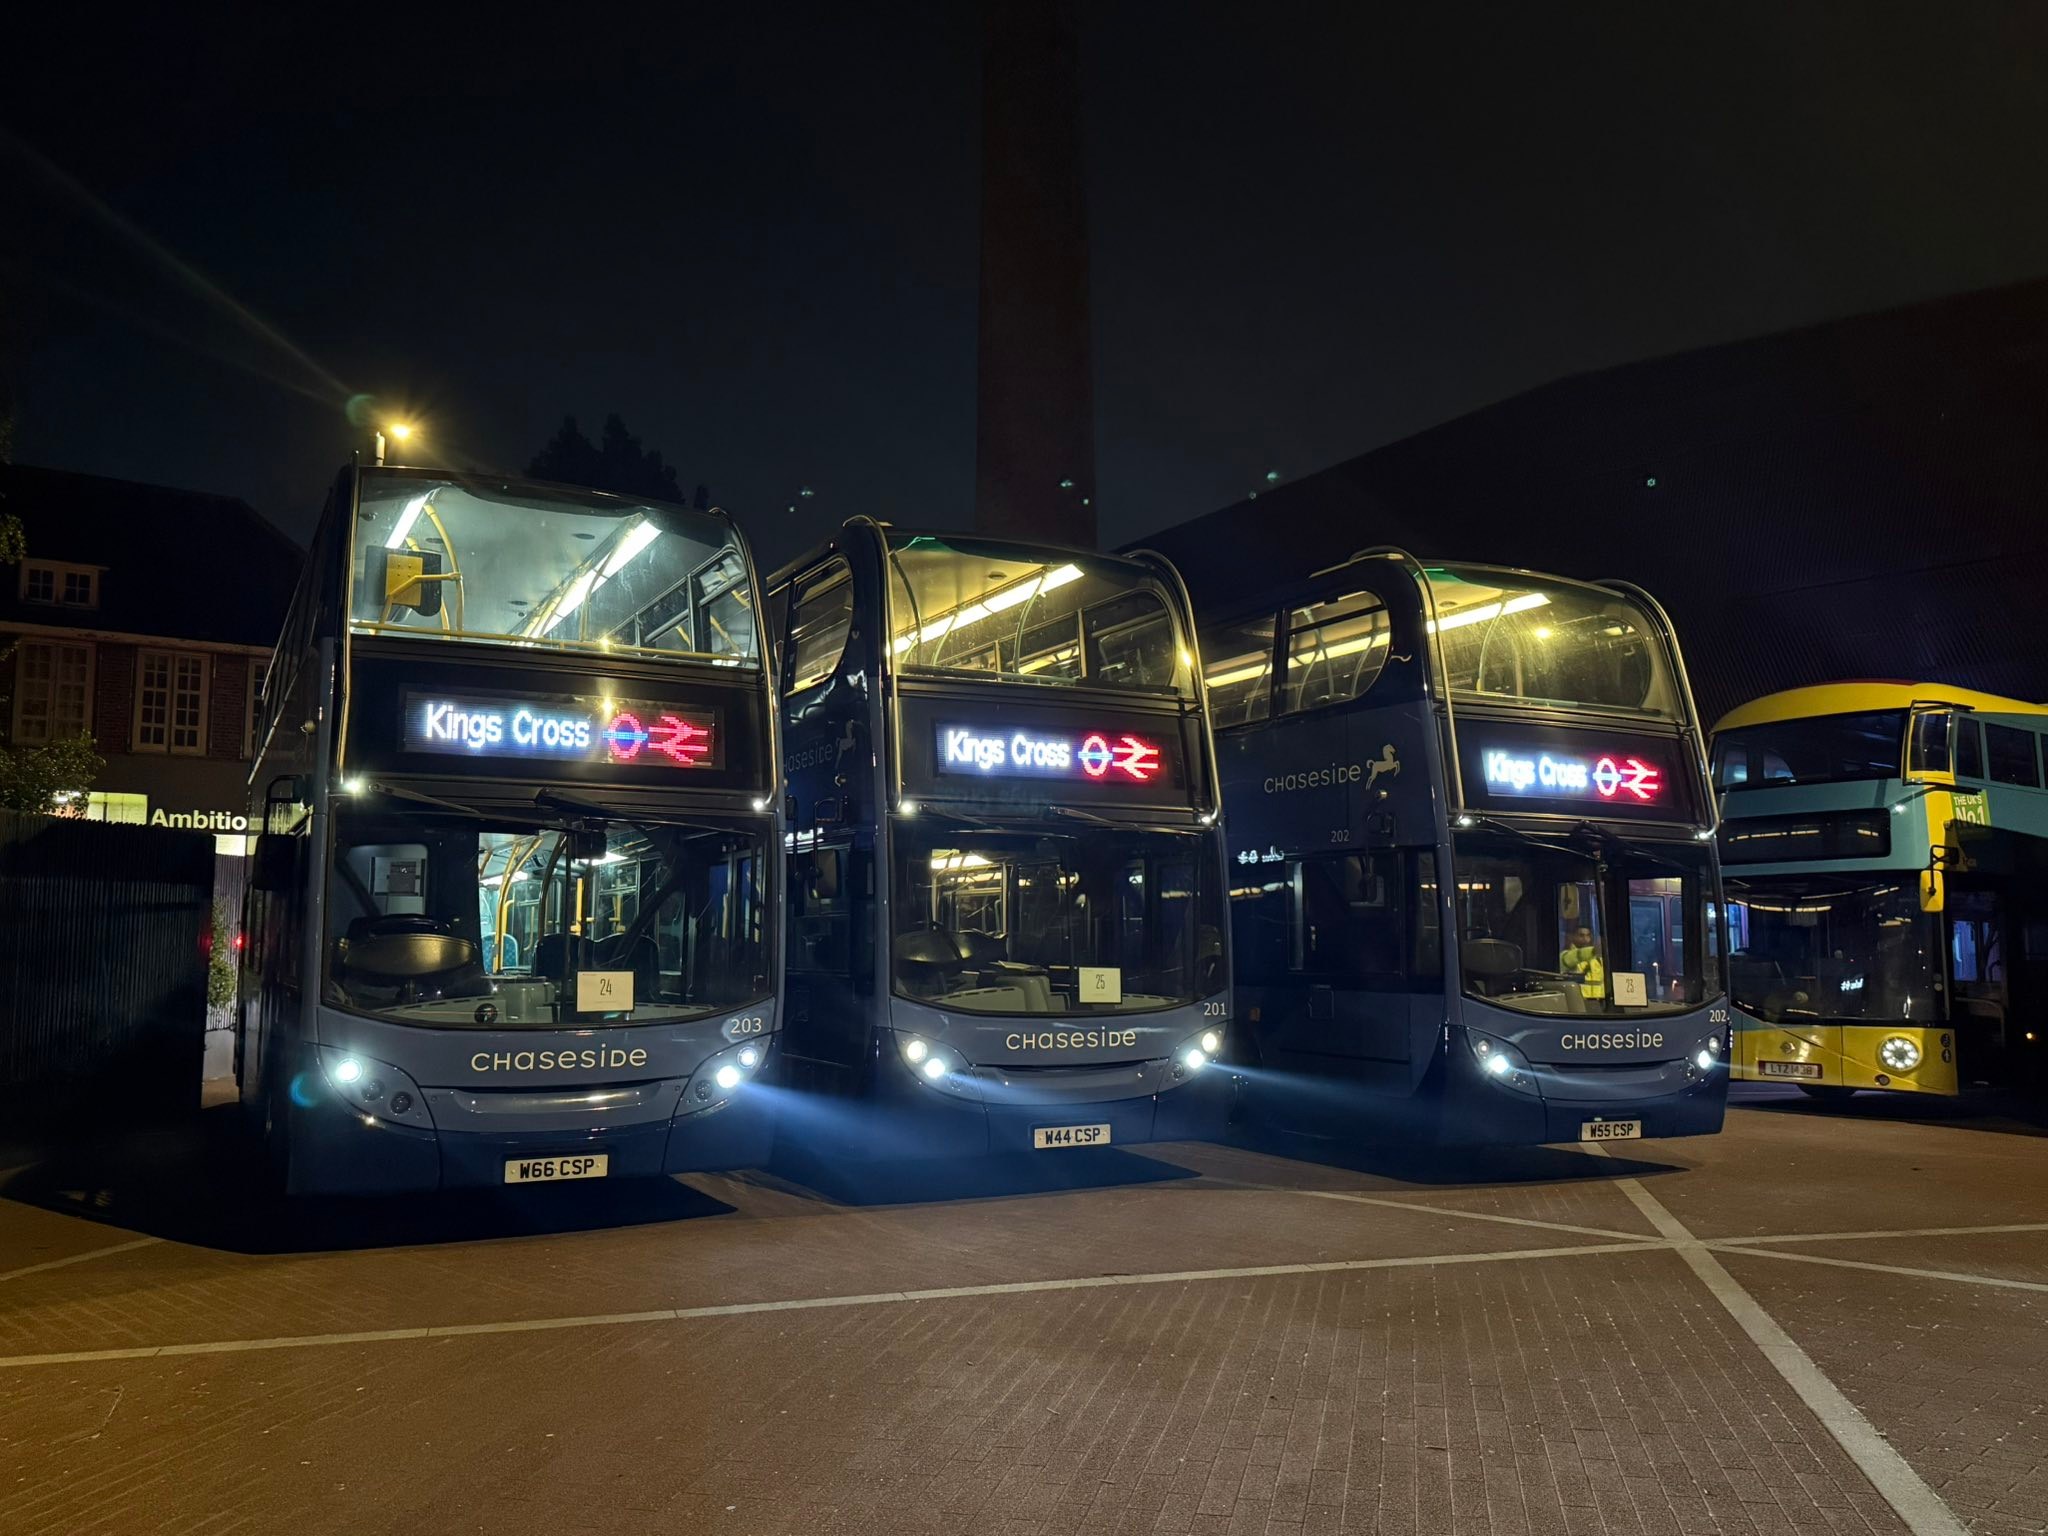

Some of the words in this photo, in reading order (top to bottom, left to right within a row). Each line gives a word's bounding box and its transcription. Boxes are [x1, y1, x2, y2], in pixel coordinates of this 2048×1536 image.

[425, 703, 502, 749] Kings
[512, 710, 592, 748] Cross
[947, 730, 1005, 770] Kings
[1011, 734, 1072, 768] Cross
[1488, 752, 1537, 791] Kings
[1539, 756, 1589, 788] Cross
[1953, 795, 1967, 806] THE
[151, 807, 248, 831] Ambitio
[1955, 804, 1986, 826] No.1
[1330, 829, 1350, 843] 202
[600, 978, 612, 996] 24
[1095, 974, 1106, 990] 25
[1203, 1002, 1228, 1016] 201
[1709, 1009, 1727, 1023] 202
[730, 1017, 762, 1034] 203
[1045, 1129, 1072, 1145] W44
[1075, 1127, 1101, 1143] CSP
[1590, 1124, 1611, 1138] W55
[1613, 1123, 1634, 1137] CSP
[520, 1161, 555, 1179] W66
[560, 1158, 595, 1176] CSP
